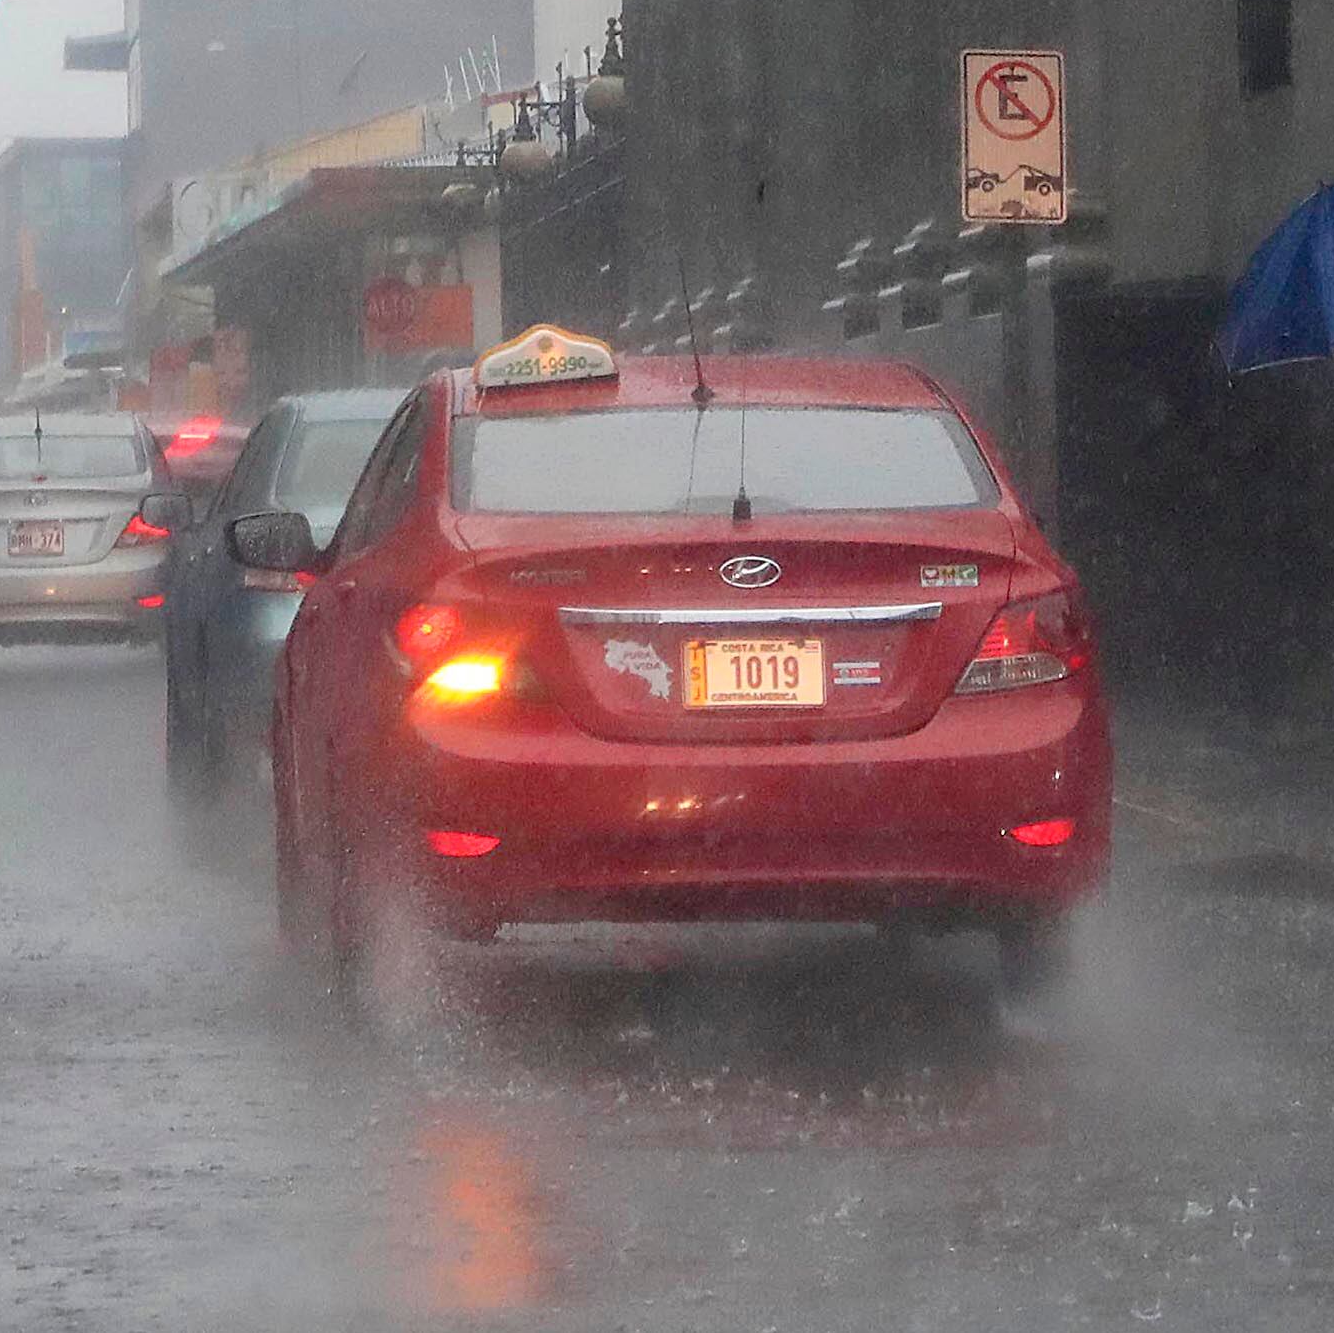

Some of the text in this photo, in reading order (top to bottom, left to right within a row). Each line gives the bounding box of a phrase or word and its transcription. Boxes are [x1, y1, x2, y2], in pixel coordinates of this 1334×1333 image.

[507, 356, 586, 376] 2251-9990
[722, 643, 785, 653] COSTA RICA
[730, 655, 800, 690] 1019
[711, 692, 798, 703] CENTROAMERICA
